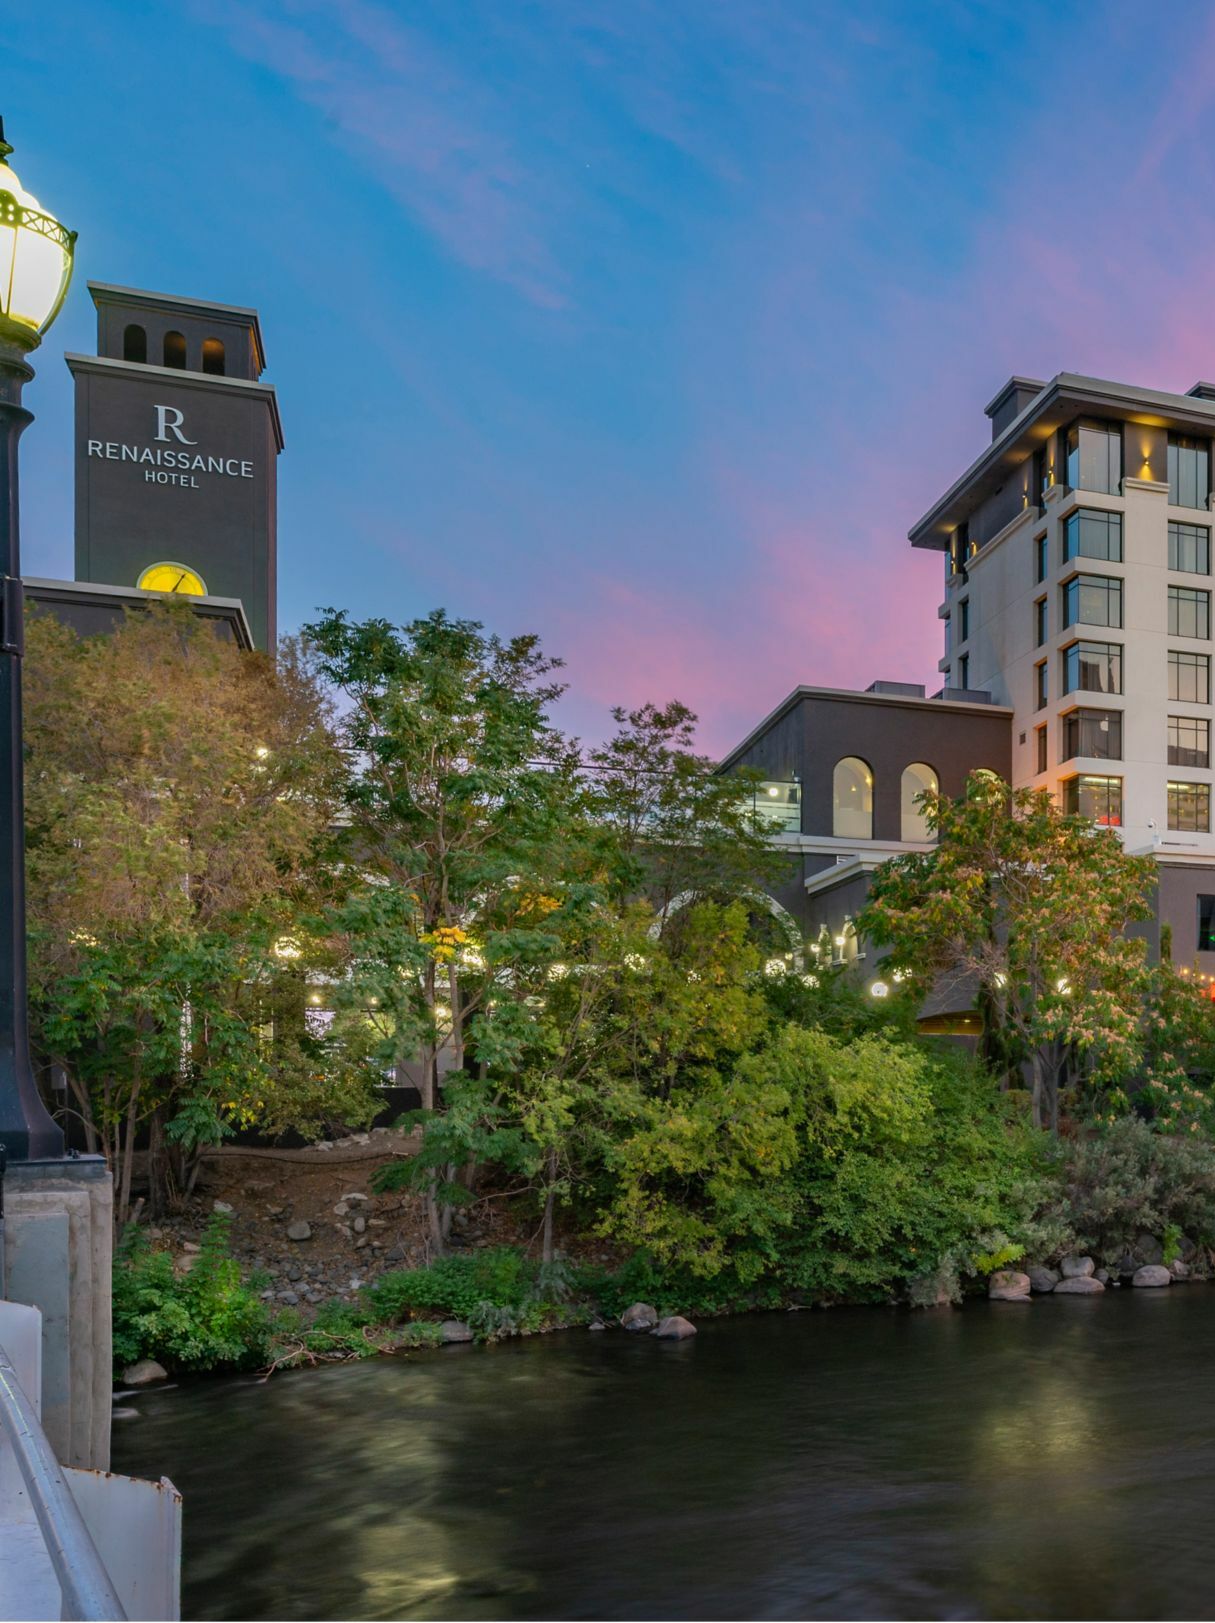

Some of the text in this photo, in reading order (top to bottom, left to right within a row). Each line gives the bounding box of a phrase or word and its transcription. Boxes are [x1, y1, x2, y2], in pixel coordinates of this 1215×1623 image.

[154, 404, 198, 445] R
[87, 439, 254, 478] RENAISSANCE
[145, 470, 199, 488] HOTEL
